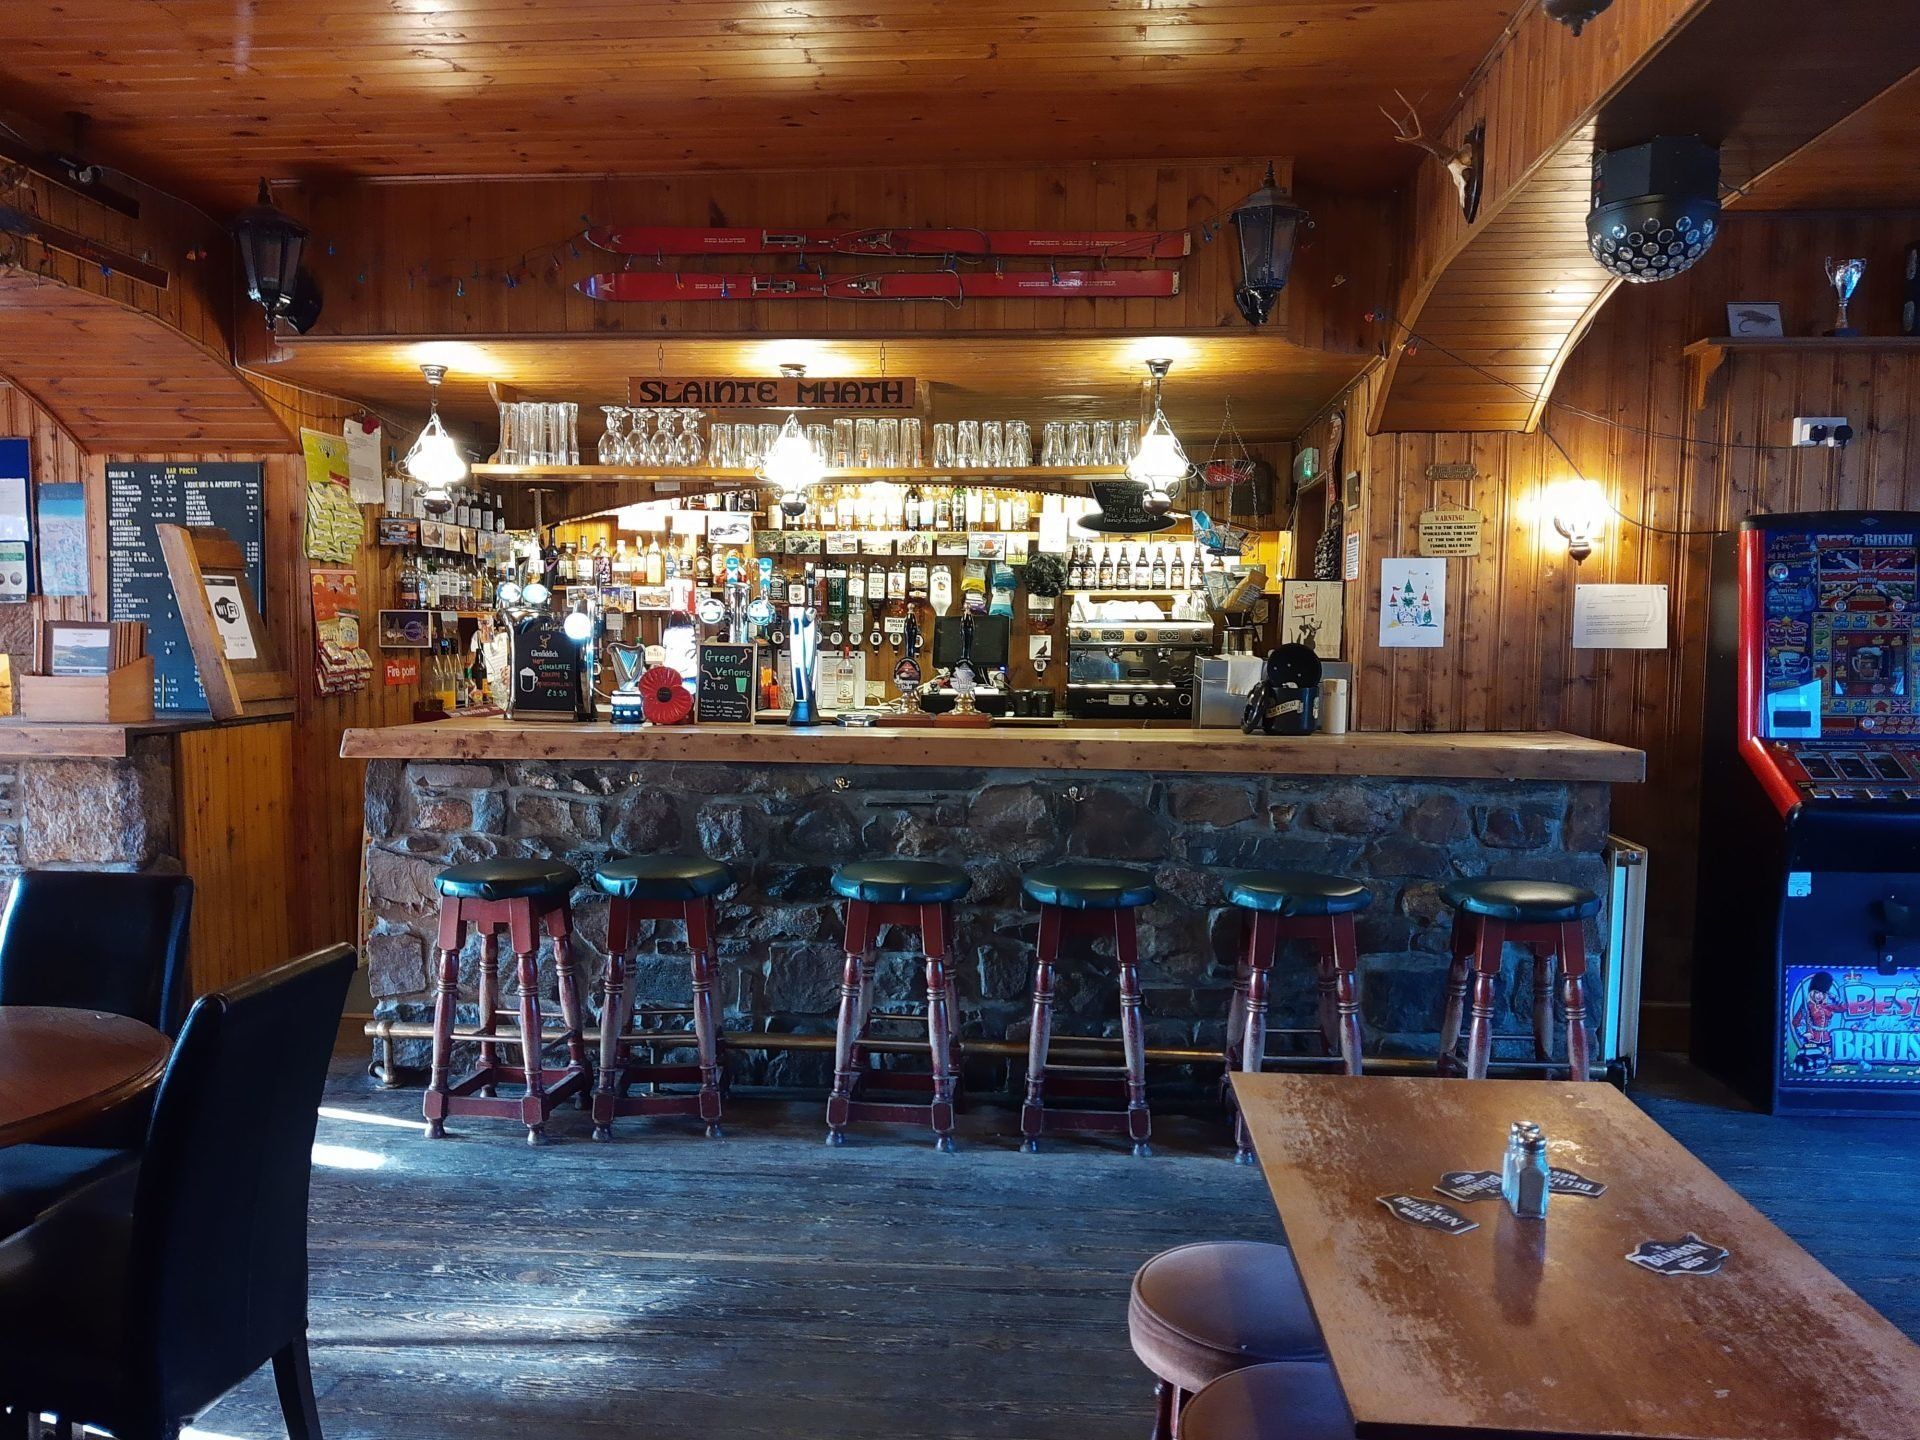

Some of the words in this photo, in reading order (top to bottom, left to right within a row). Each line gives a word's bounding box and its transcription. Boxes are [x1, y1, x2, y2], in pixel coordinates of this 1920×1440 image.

[796, 380, 904, 403] MHATH
[1816, 534, 1855, 548] BEST
[1863, 534, 1913, 546] BRITISH
[110, 550, 130, 558] SPIRITS
[531, 650, 559, 658] Glenfiddich
[705, 650, 738, 663] Green
[386, 666, 400, 677] Fire
[402, 666, 416, 678] point
[716, 667, 751, 678] Venoms
[1452, 1174, 1476, 1184] BEST
[1393, 1196, 1464, 1226] BELHAVEN
[1400, 1207, 1432, 1222] BEST
[1644, 1242, 1709, 1267] BELHAVEN
[1678, 1256, 1709, 1269] BEST
